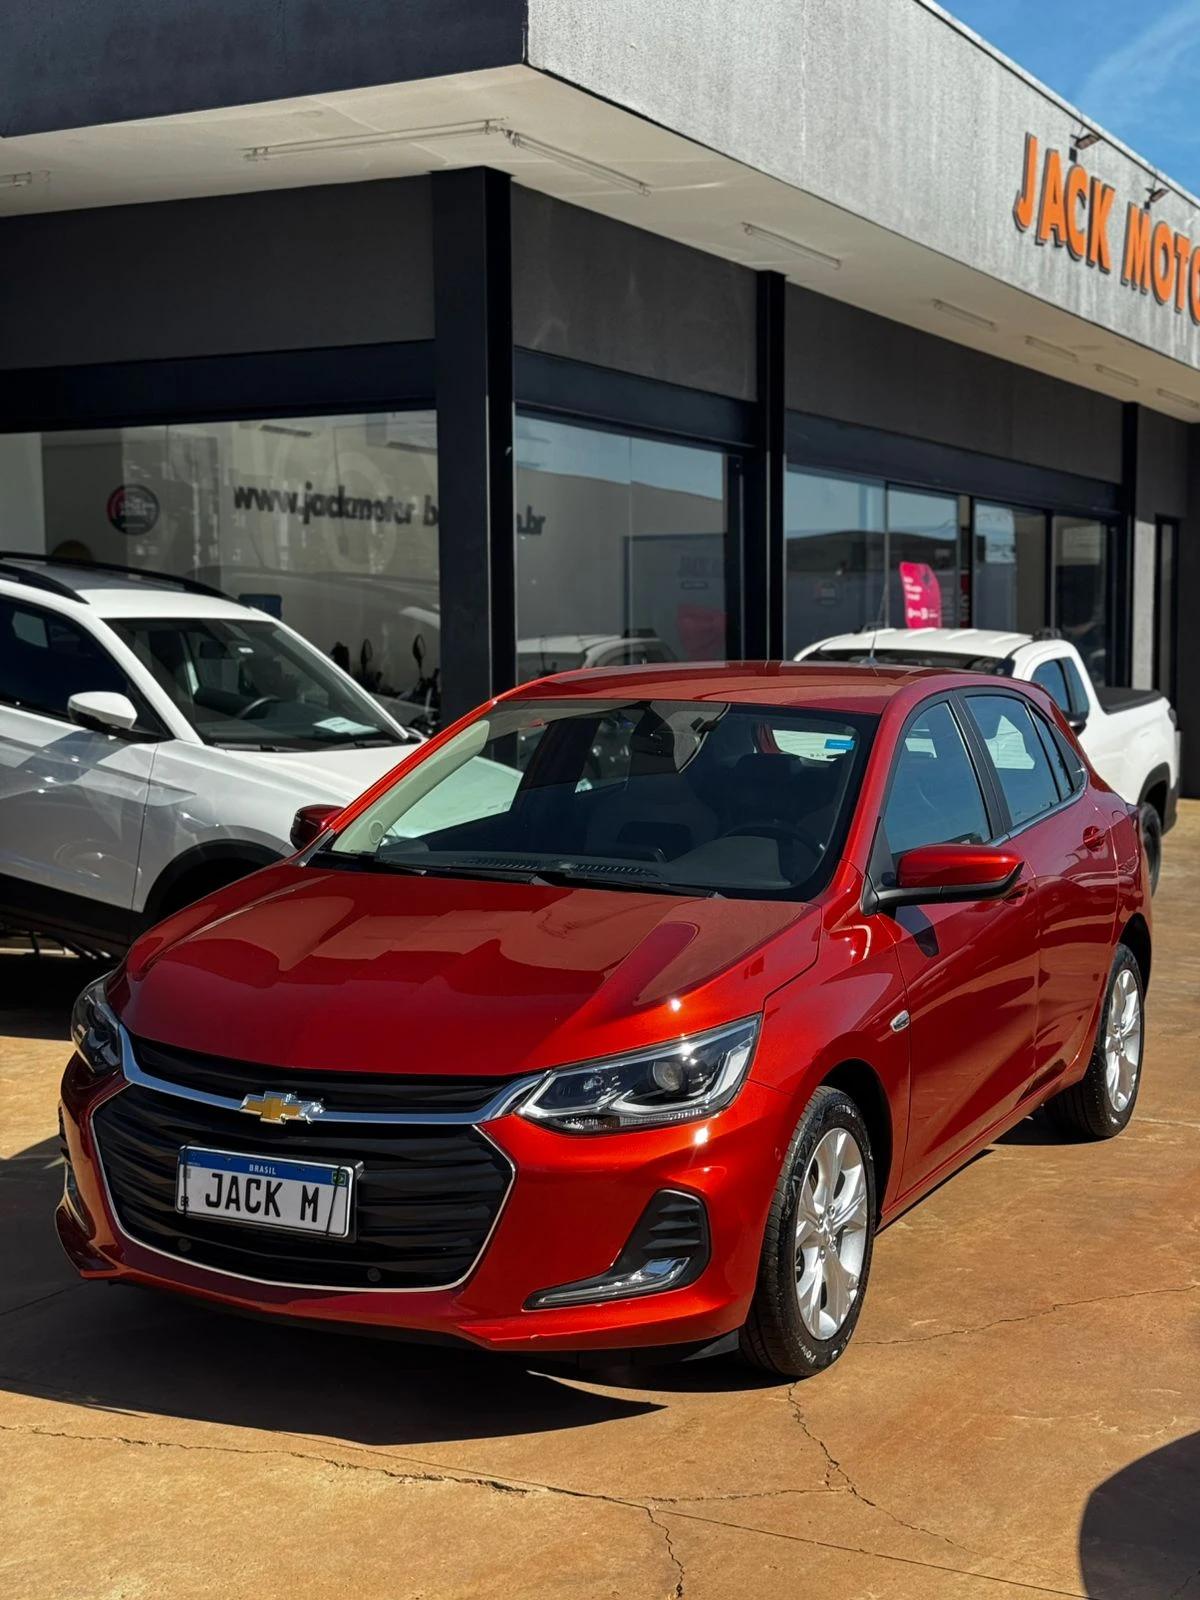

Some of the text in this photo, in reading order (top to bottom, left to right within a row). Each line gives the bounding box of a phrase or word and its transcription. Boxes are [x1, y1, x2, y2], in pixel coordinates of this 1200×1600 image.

[1013, 132, 1115, 274] JACK
[249, 1164, 277, 1175] BRASIL
[205, 1173, 320, 1223] JACK M
